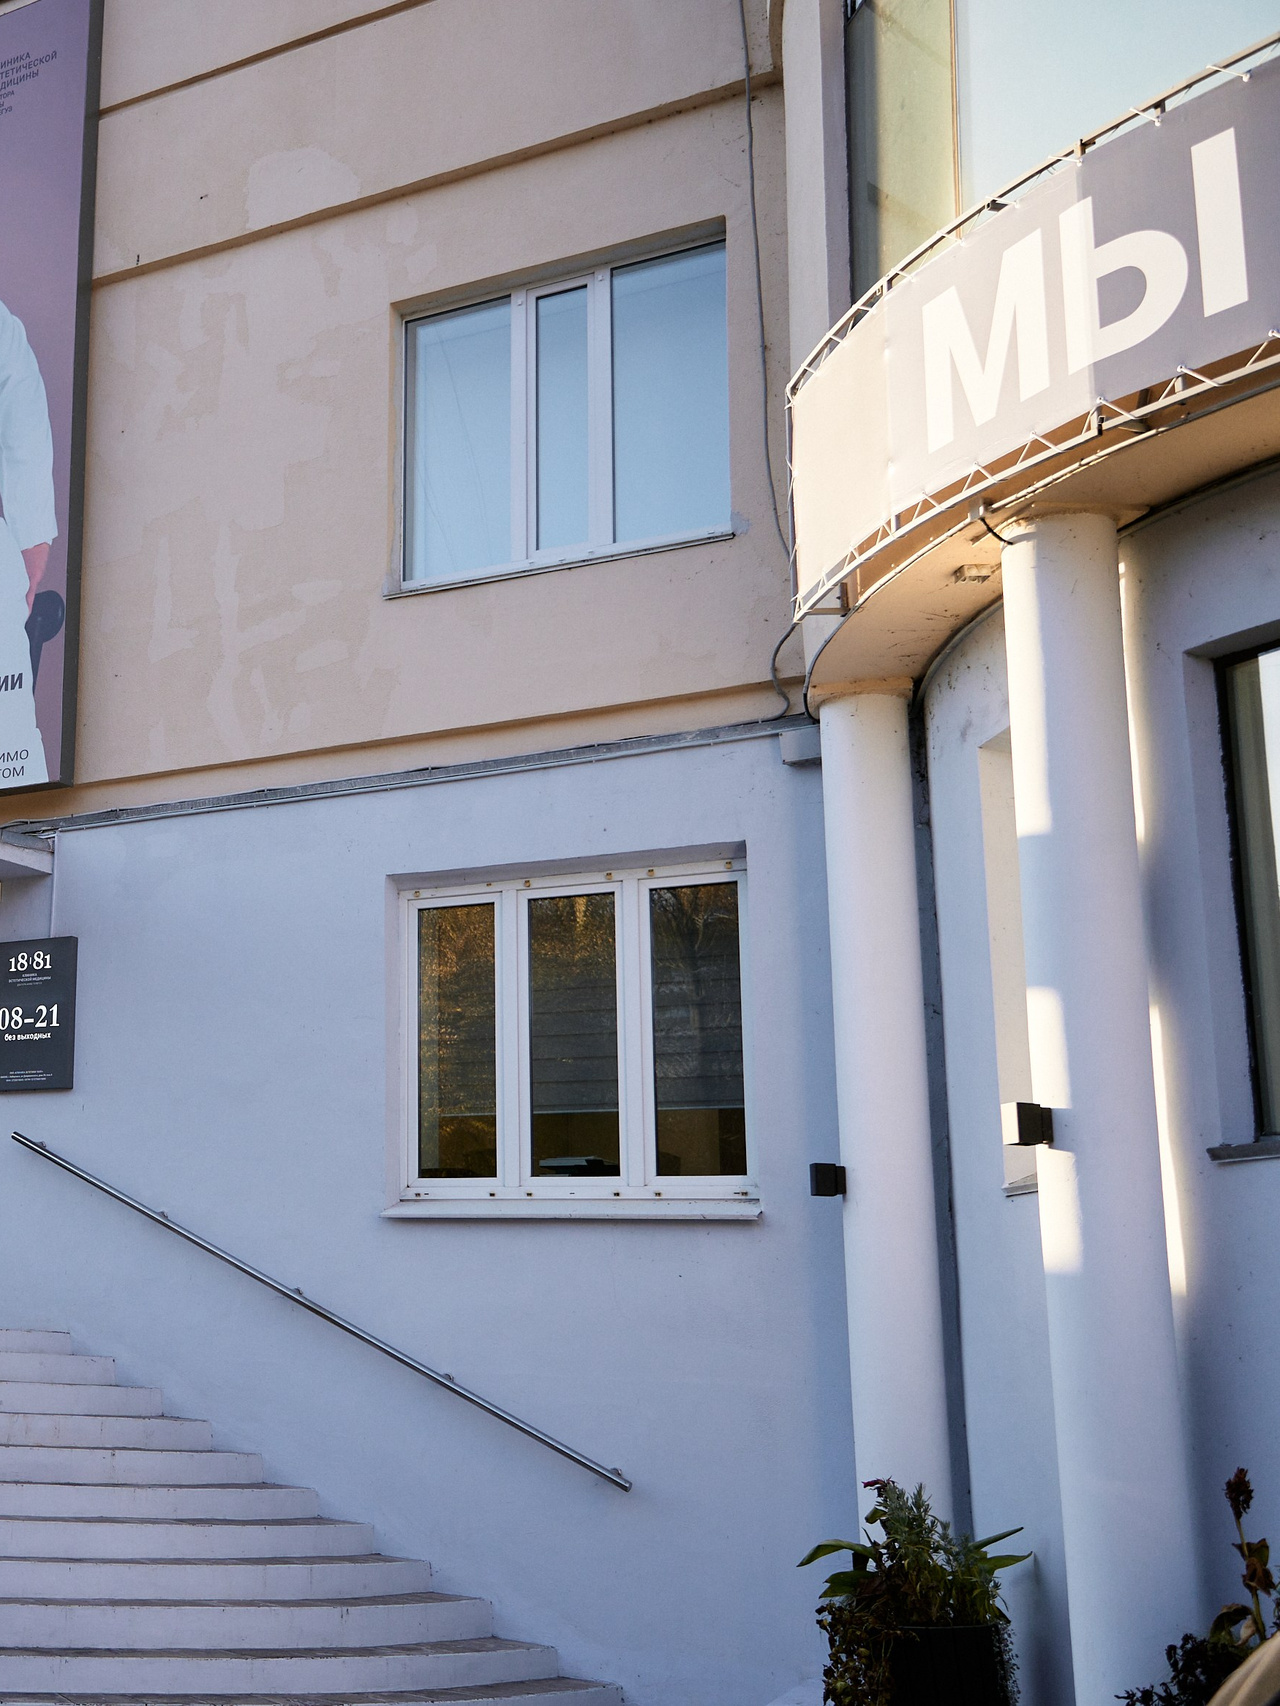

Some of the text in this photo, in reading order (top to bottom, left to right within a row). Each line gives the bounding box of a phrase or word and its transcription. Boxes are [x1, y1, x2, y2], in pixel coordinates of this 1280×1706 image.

[921, 127, 1249, 455] МЫ
[4, 1031, 51, 1042] без выходных
